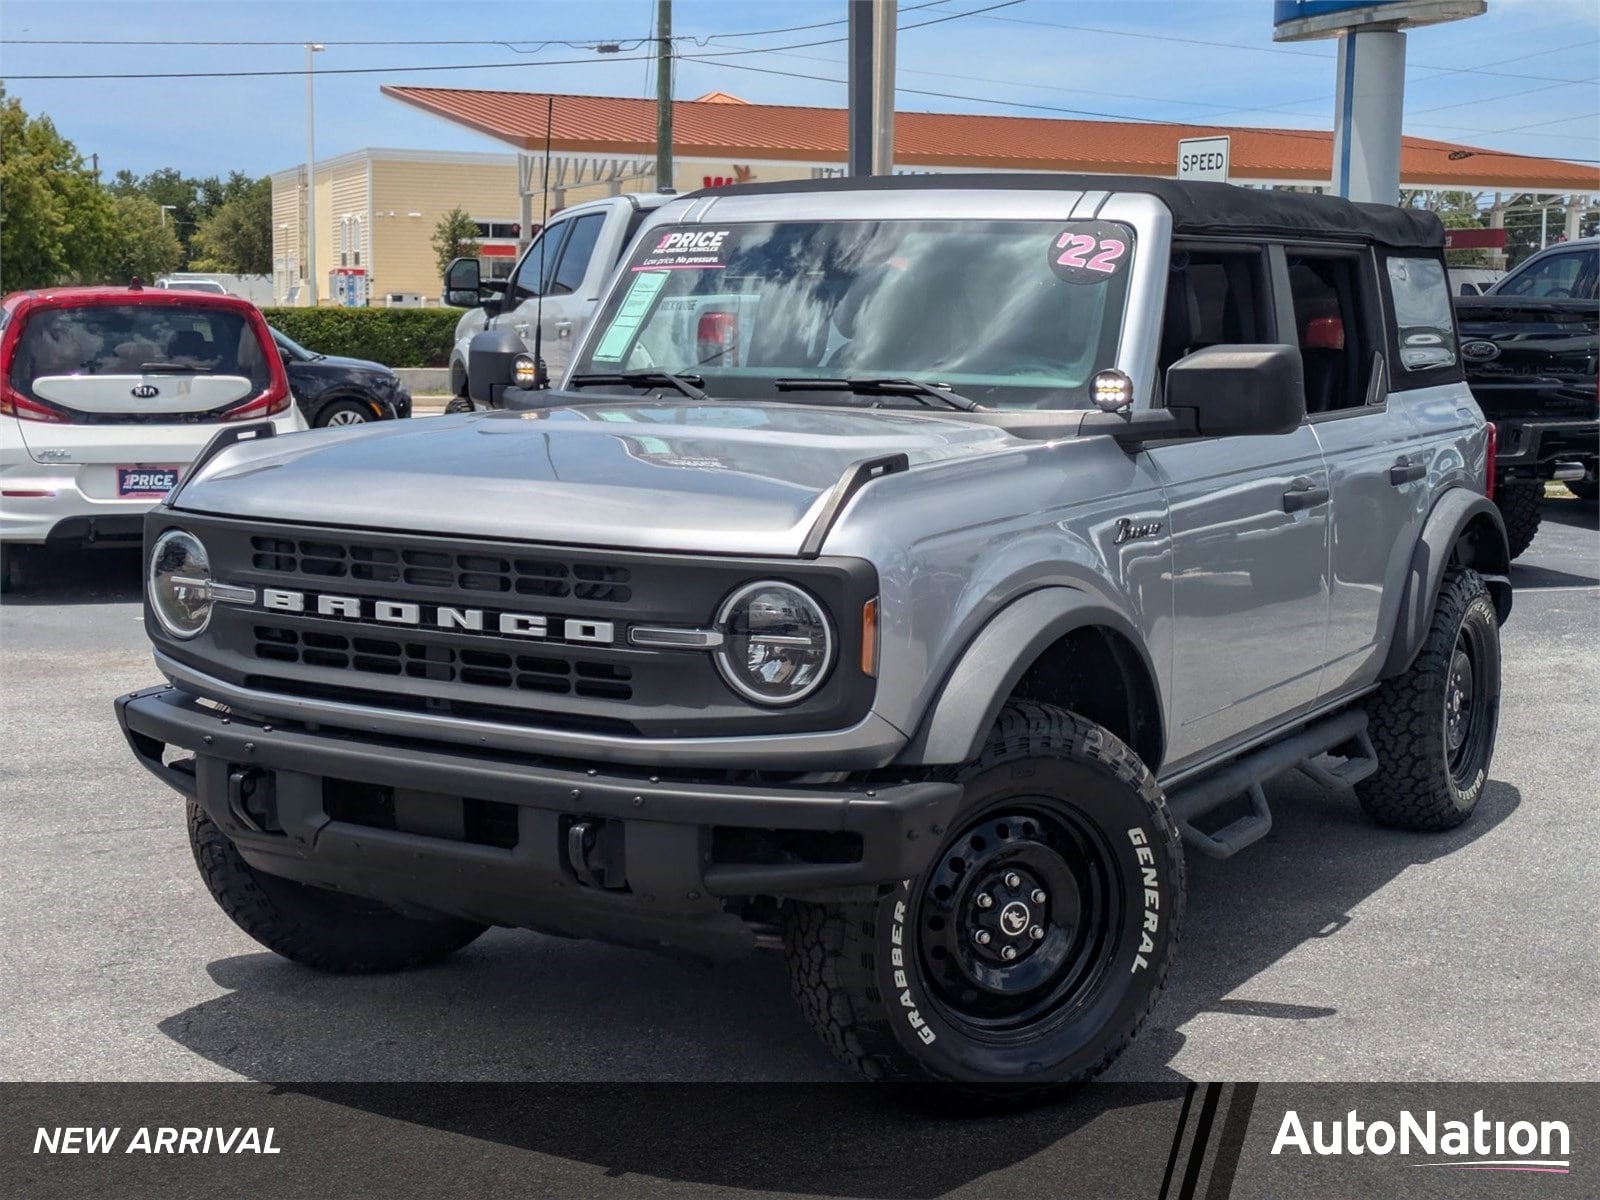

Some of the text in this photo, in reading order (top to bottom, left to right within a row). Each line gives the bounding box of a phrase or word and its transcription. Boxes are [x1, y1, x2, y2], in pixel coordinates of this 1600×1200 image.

[1182, 152, 1224, 172] SPEED
[135, 387, 155, 396] KIA
[263, 588, 614, 643] BRONCO
[1127, 827, 1160, 975] GENERAL
[891, 900, 937, 1046] GRABBER
